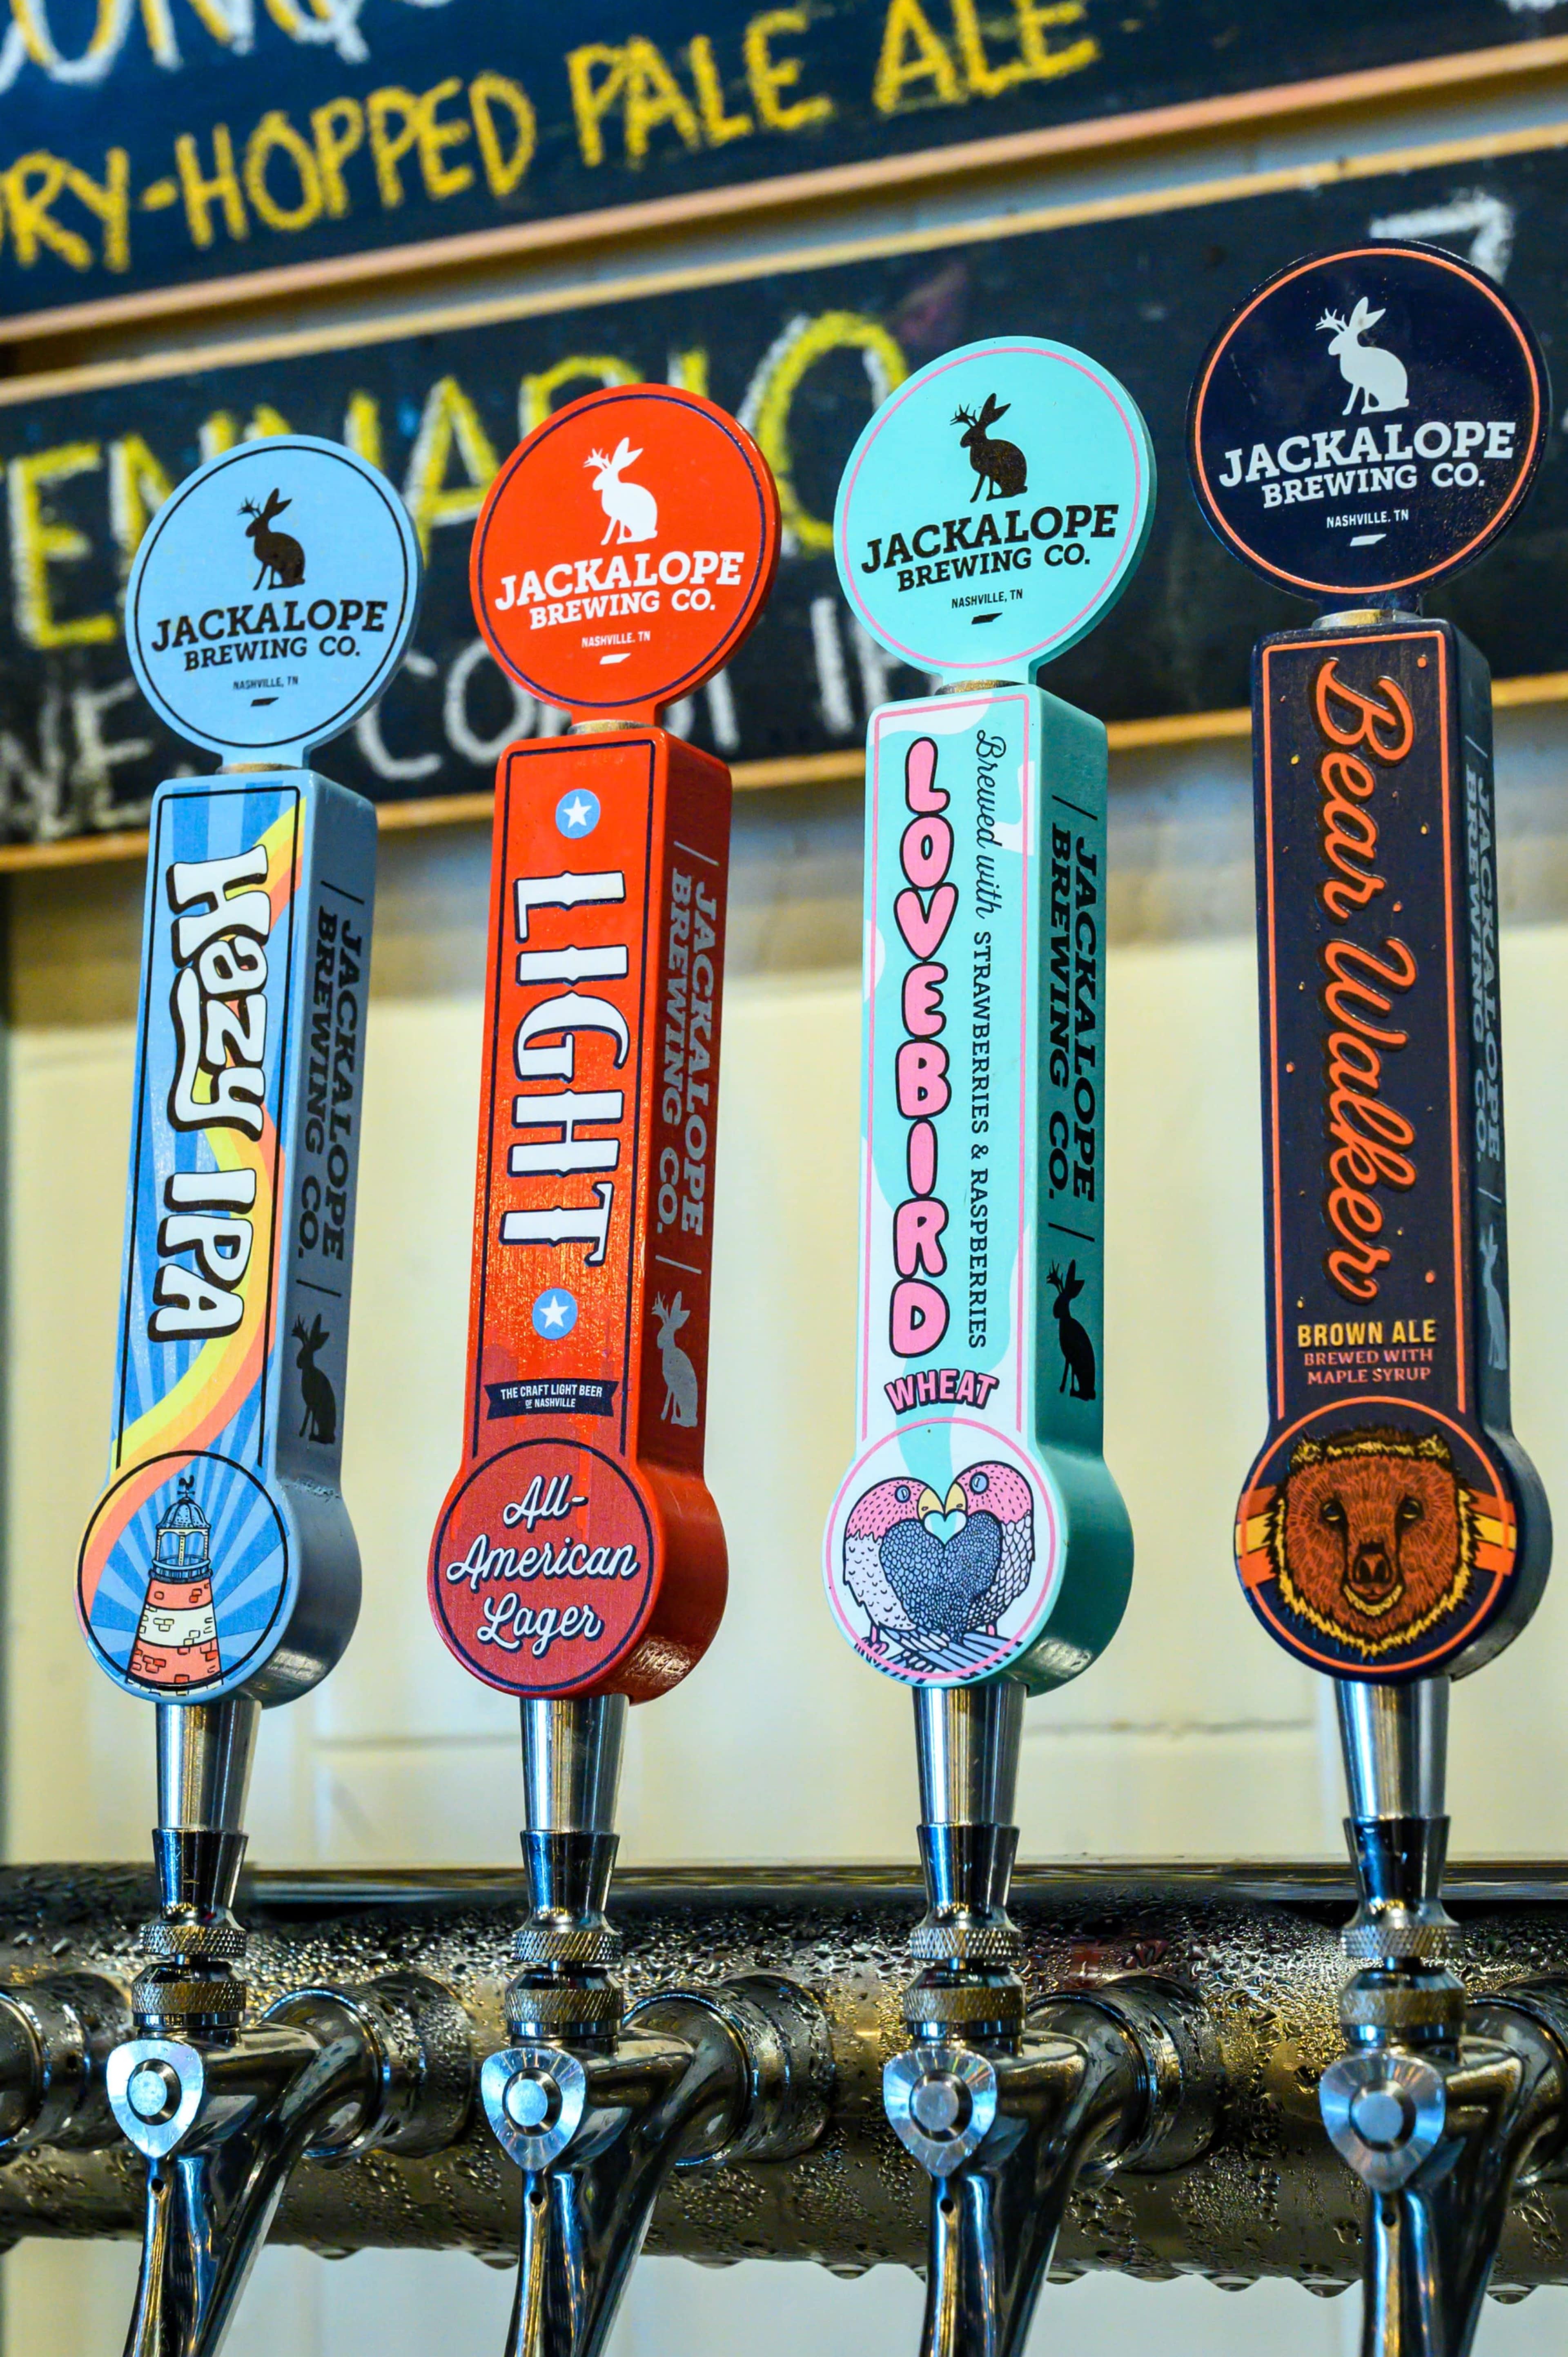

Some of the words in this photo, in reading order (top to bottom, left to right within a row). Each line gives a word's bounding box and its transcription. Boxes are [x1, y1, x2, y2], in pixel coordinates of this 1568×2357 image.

[0, 69, 536, 272] RY-HOPPED
[566, 8, 835, 167] PALE
[873, 0, 1100, 115] ALE
[1218, 421, 1516, 487] JACKALOPE
[1262, 465, 1417, 508] BREWING
[1431, 462, 1485, 487] CO.
[861, 504, 1119, 573] JACKALOPE
[1394, 509, 1409, 521] TN
[495, 551, 744, 610] JACKALOPE
[897, 548, 1031, 591] BREWING
[1044, 544, 1090, 566] CO.
[951, 591, 1007, 608] NASHVILLE,
[1010, 589, 1022, 600] TN
[151, 599, 388, 651] JACKALOPE
[529, 591, 660, 630] BREWING
[671, 589, 716, 611] CO.
[638, 631, 650, 642] TN
[184, 638, 307, 671] BREWING
[319, 636, 360, 656] CO.
[233, 676, 284, 690] NASHVILLE,
[287, 676, 298, 685] TN
[976, 729, 1006, 849] Brewed
[1310, 657, 1414, 926] Bear
[976, 854, 1002, 919] with
[1050, 823, 1071, 1088] BREWING
[1477, 776, 1501, 1162] JACKALOPE
[167, 844, 271, 1142] Hazy
[663, 868, 690, 1125] BREWING
[1073, 836, 1096, 1202] JACKALOPE
[306, 905, 338, 1155] BREWING
[682, 882, 717, 1236] JACKALOPE
[889, 736, 959, 1358] LOVEBIRD
[971, 931, 991, 1133] STRAWBERRIES
[323, 919, 361, 1261] JACKALOPE
[499, 871, 629, 1267] LIGHT
[971, 1144, 989, 1160] &
[1317, 937, 1419, 1303] Walker
[1049, 1110, 1069, 1200] CO.
[297, 1176, 321, 1259] CO.
[657, 1147, 679, 1233] CO.
[148, 1168, 256, 1342] IPA
[969, 1168, 988, 1349] RASPBERRIES
[1297, 1322, 1383, 1348] BROWN
[1392, 1319, 1437, 1344] ALE
[1304, 1350, 1379, 1366] BREWED
[1383, 1348, 1433, 1362] WITH
[501, 1387, 518, 1400] THE
[520, 1385, 549, 1397] CRAFT
[551, 1384, 577, 1395] LIGHT
[579, 1385, 602, 1397] BEER
[535, 1398, 576, 1407] NASHVILLE
[884, 1368, 998, 1415] WHEAT
[1307, 1369, 1368, 1385] MAPLE
[1372, 1367, 1431, 1382] SYRUP
[503, 1475, 588, 1532] All-
[446, 1534, 639, 1592] American
[477, 1591, 603, 1657] Lager
